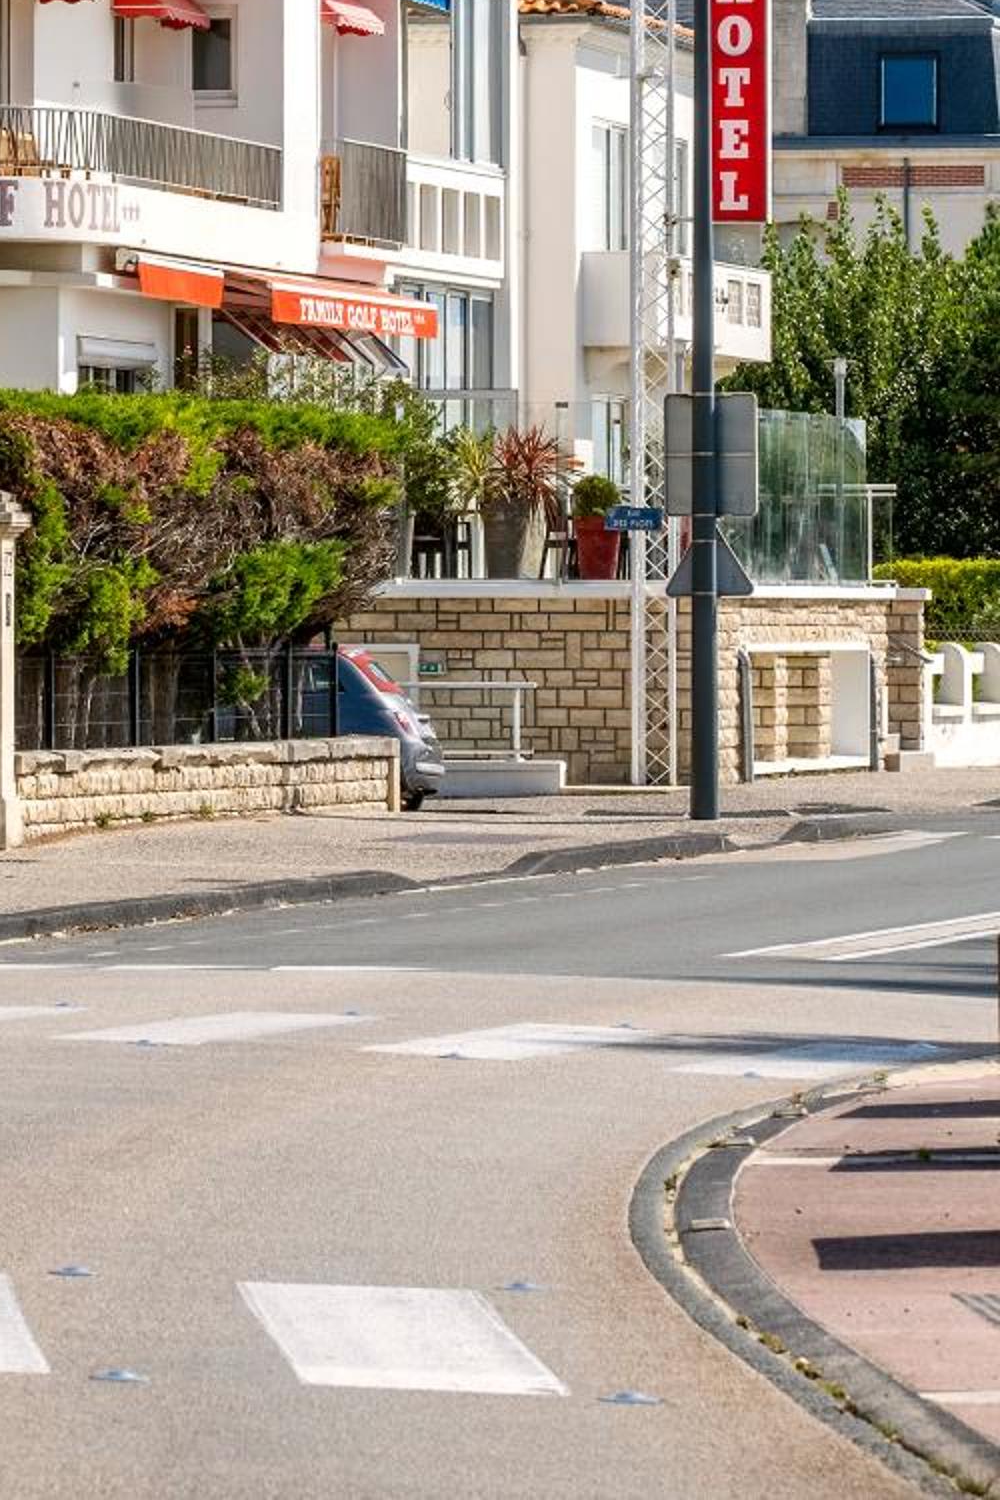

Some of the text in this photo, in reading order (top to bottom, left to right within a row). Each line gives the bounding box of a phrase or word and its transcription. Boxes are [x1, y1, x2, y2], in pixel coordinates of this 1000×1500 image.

[43, 180, 121, 233] HOTEL
[299, 298, 415, 334] FAMILY GOLF HOTEL
